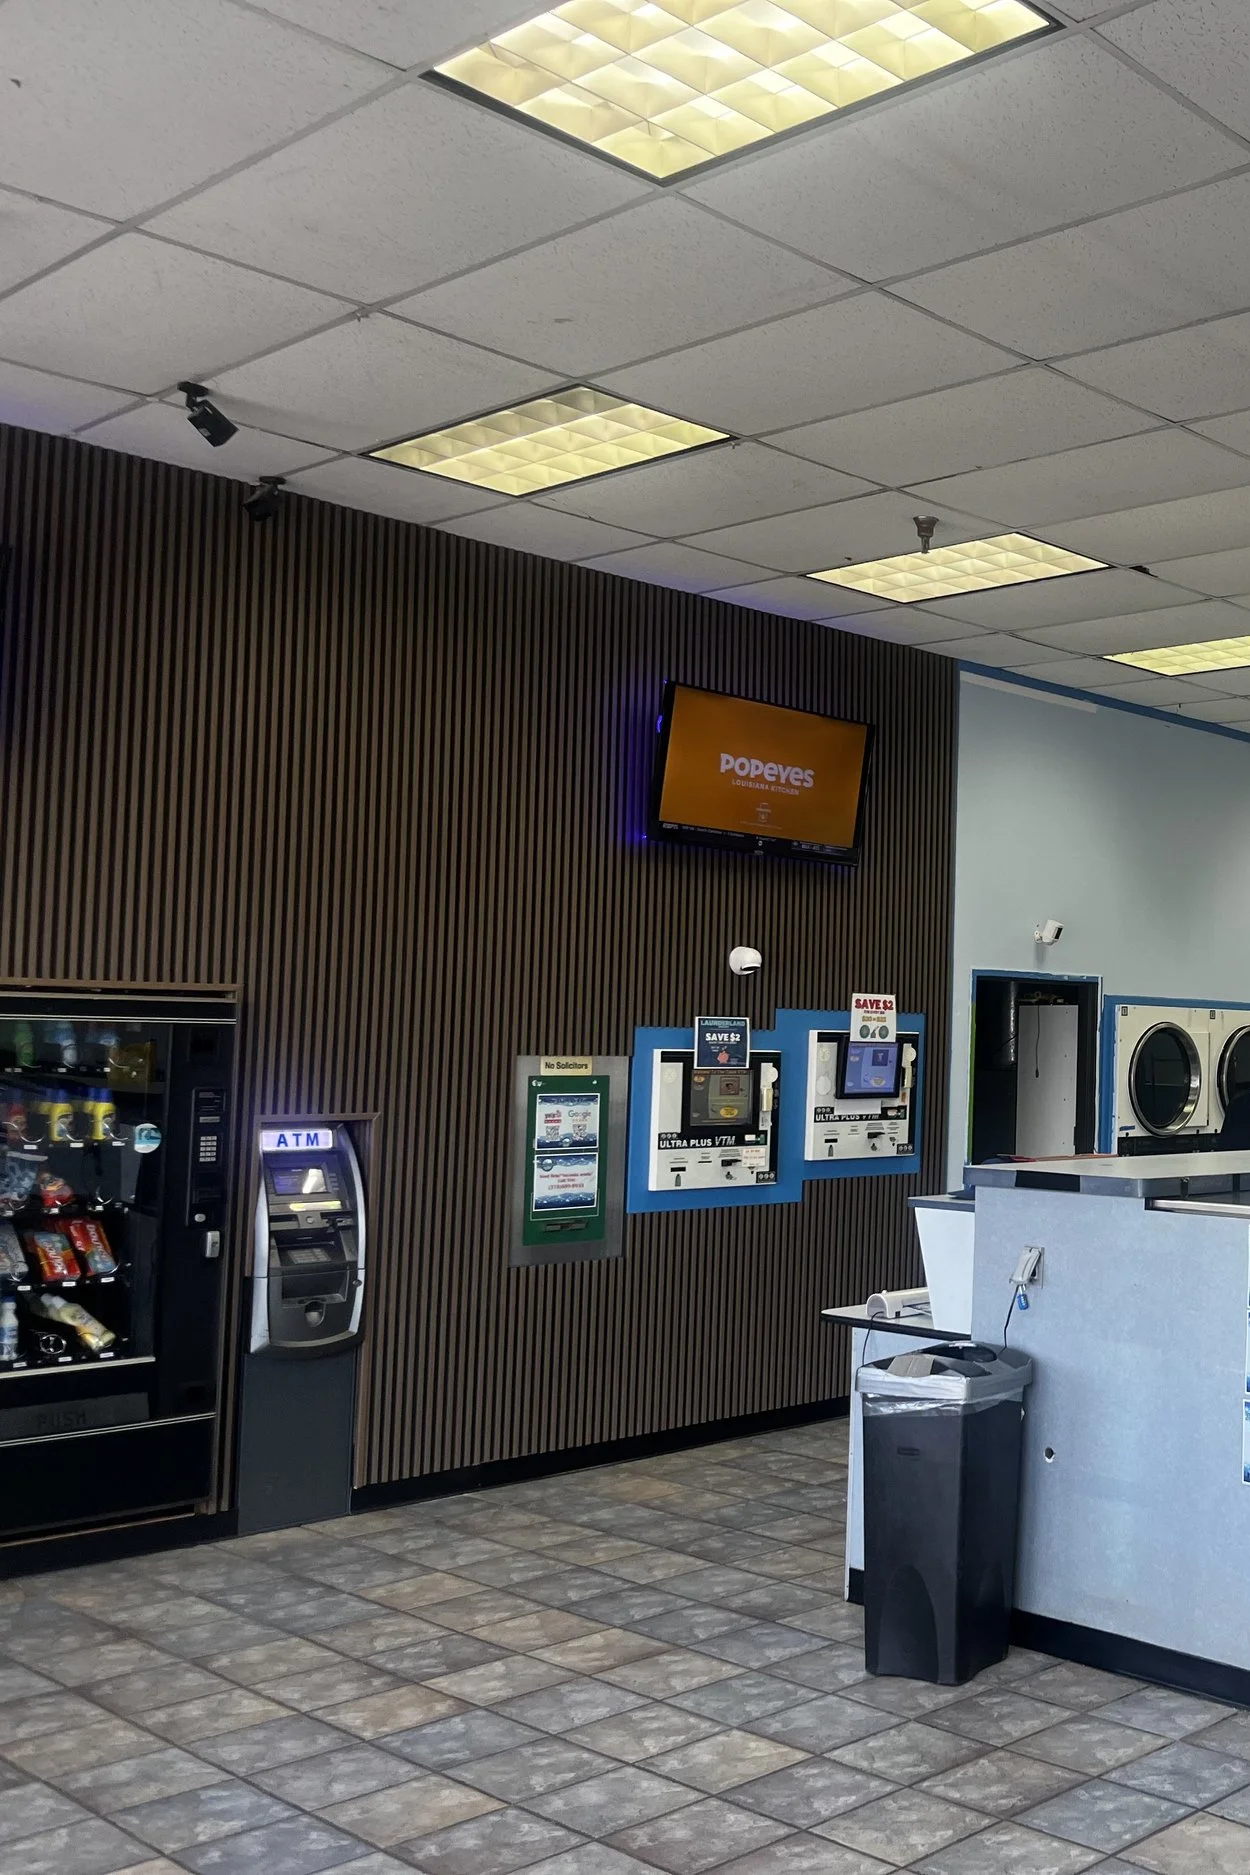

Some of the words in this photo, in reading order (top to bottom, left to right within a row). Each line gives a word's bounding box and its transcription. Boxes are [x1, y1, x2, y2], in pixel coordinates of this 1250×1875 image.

[732, 779, 770, 791] LOUISIANA
[770, 785, 800, 796] KITCHEN
[855, 998, 881, 1010] SAVE
[882, 999, 894, 1011] $2
[705, 1032, 729, 1042] SAVE
[730, 1032, 741, 1042] $2
[544, 1061, 555, 1070] No
[556, 1061, 589, 1070] Solicitors
[276, 1132, 320, 1148] ATM
[659, 1139, 688, 1149] ULTRA
[689, 1138, 713, 1147] PLUS
[714, 1135, 736, 1146] VTM
